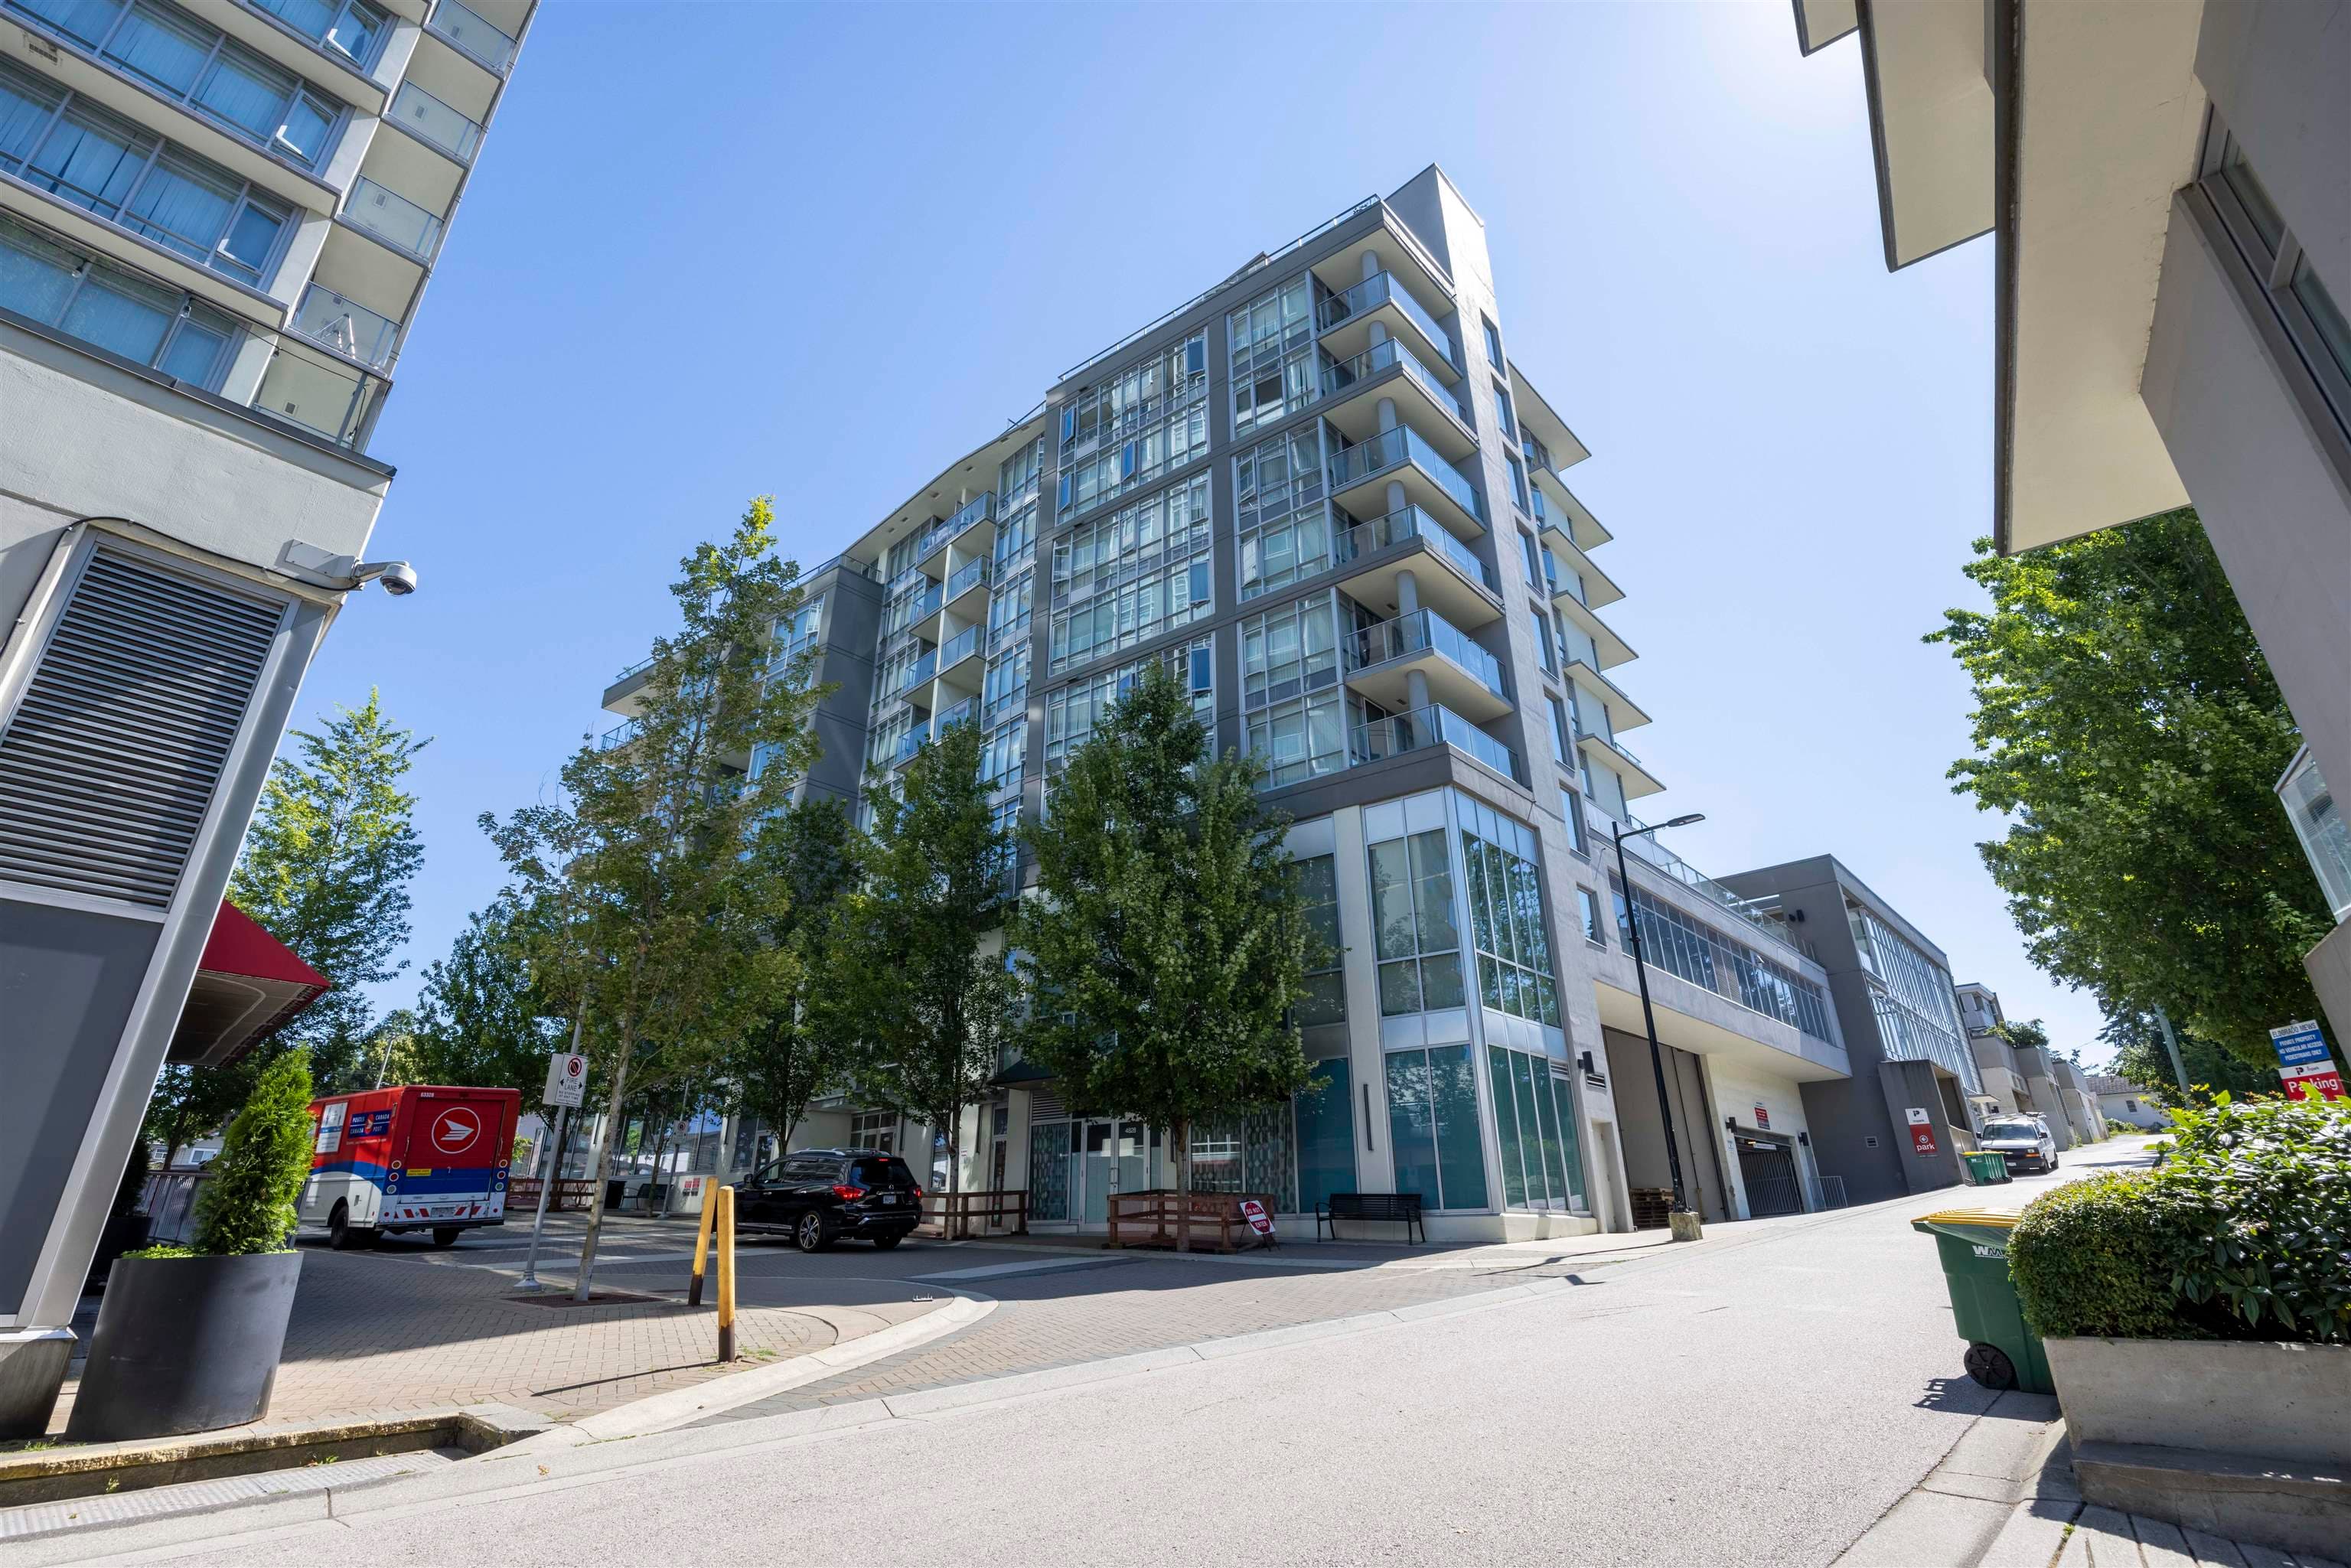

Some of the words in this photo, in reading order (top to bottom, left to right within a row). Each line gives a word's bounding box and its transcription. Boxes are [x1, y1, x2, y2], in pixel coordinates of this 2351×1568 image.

[2295, 1035, 2316, 1043] PROPERTY
[2287, 1077, 2339, 1093] Paking
[1916, 1143, 1935, 1152] park
